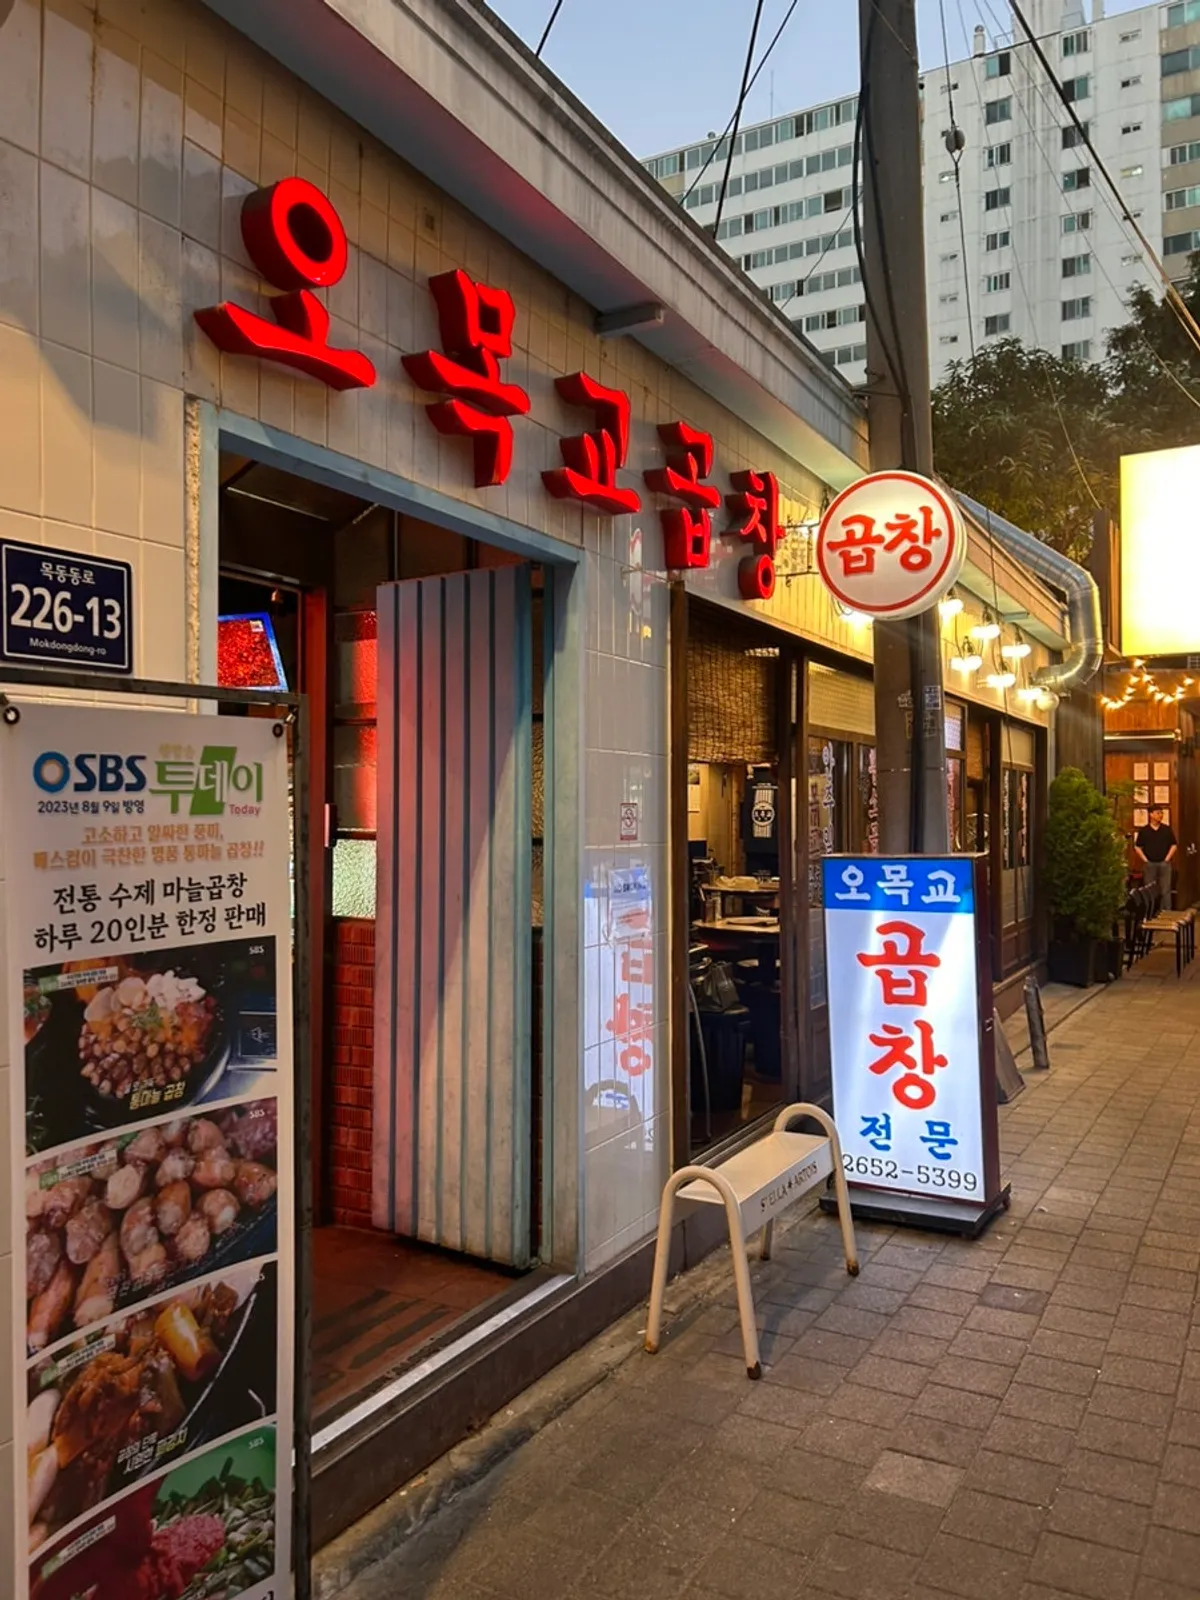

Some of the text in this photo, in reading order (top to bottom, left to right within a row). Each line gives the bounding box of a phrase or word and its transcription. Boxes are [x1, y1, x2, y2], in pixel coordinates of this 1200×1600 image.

[193, 176, 787, 600] 오목교곱창
[826, 505, 943, 578] 곱창
[40, 561, 96, 587] 목동동로
[10, 583, 122, 640] 226-13
[29, 637, 108, 656] Mokdongdong-ro
[73, 753, 147, 793] SBS
[148, 759, 263, 815] 투데이
[37, 799, 145, 815] 2023년 8월 9일 방영
[229, 803, 261, 817] Today
[81, 824, 143, 846] 고소하고
[53, 872, 248, 915] 전통 수제 마늘곱창
[834, 864, 962, 906] 오목교
[34, 901, 266, 954] 하루 20인분 한정 판매
[856, 920, 949, 1111] 곱창
[859, 1112, 959, 1161] 전문
[841, 1153, 978, 1192] 2652-5399
